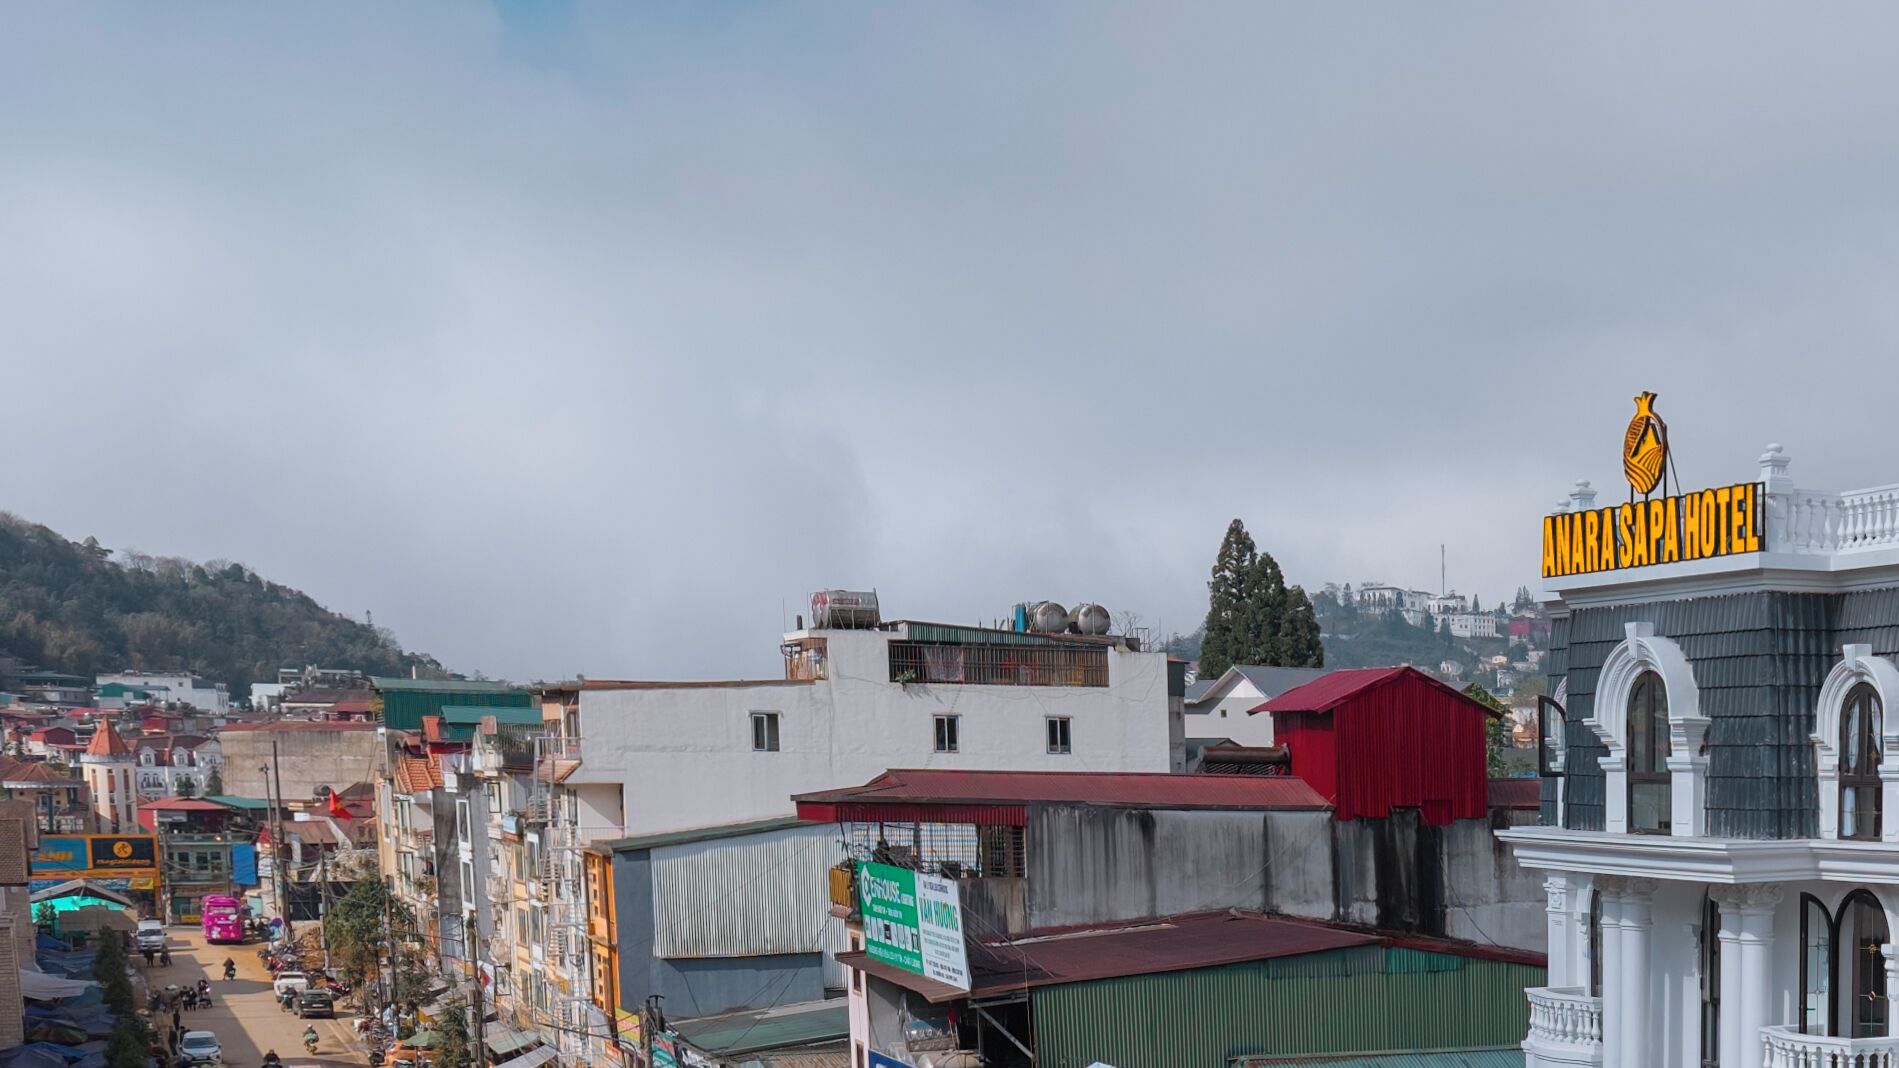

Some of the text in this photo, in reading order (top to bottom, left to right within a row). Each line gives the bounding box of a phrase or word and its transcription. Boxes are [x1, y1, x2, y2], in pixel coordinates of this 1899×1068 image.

[1542, 482, 1760, 578] ANARA SAPA HOTEL
